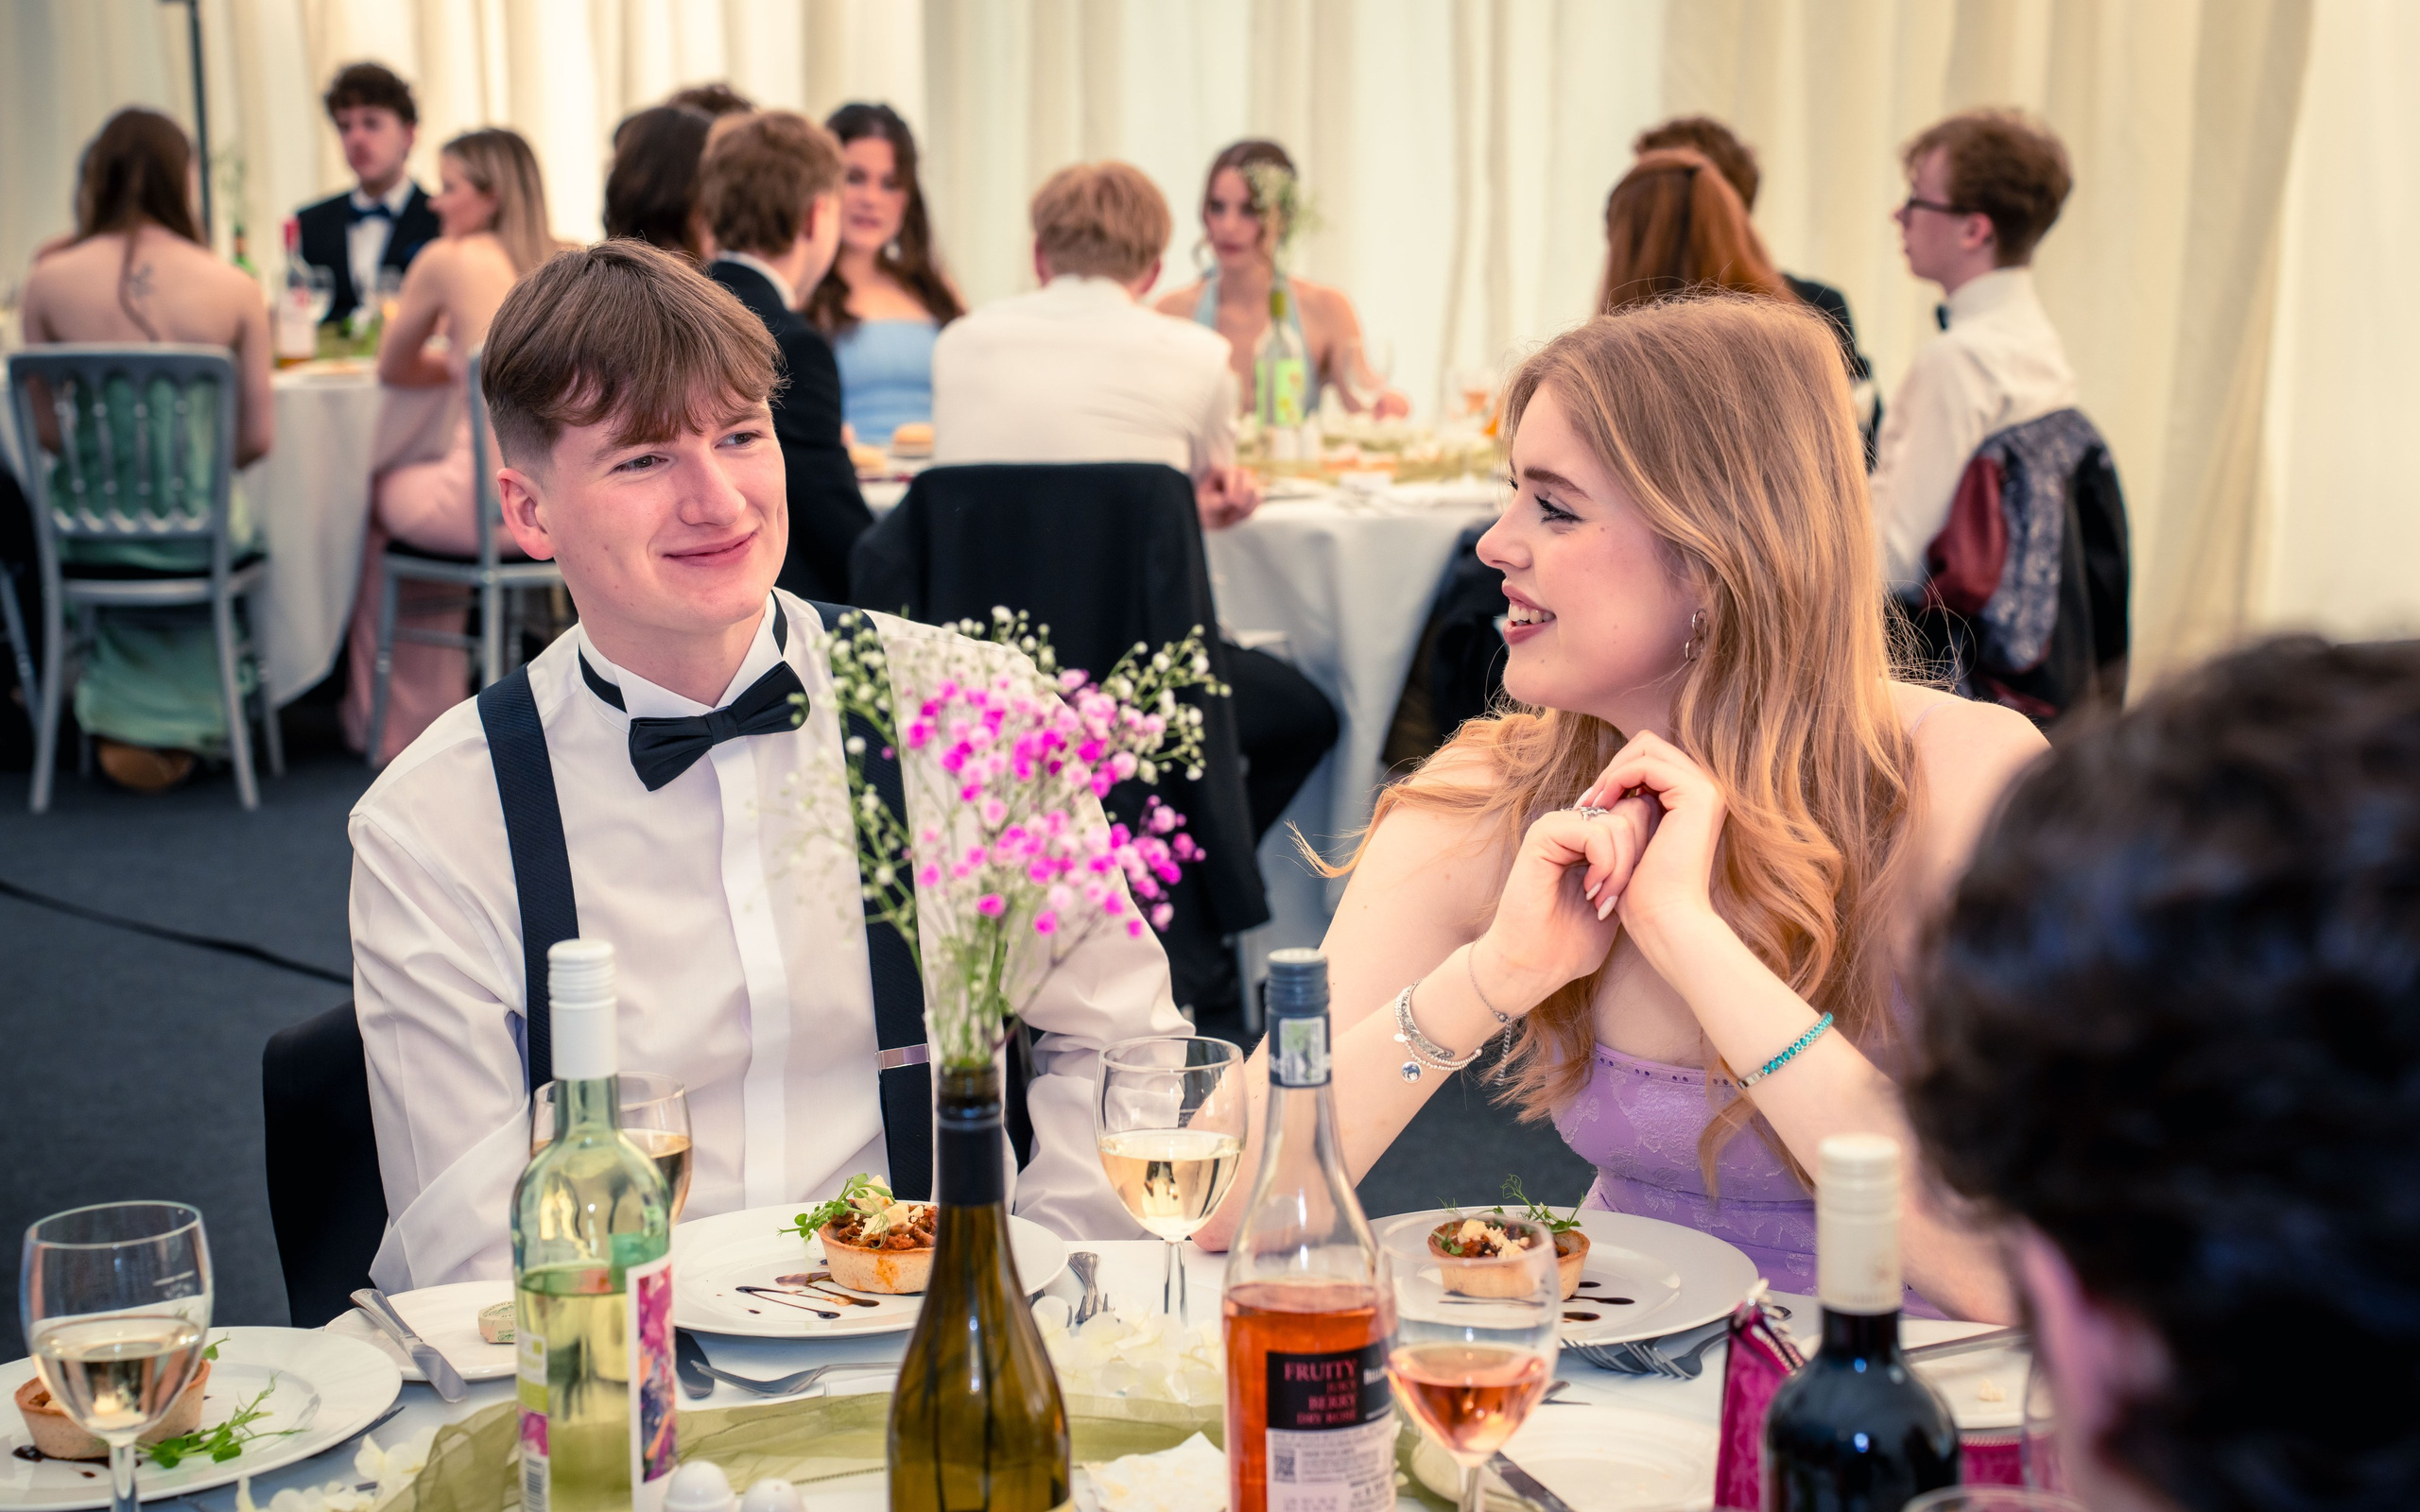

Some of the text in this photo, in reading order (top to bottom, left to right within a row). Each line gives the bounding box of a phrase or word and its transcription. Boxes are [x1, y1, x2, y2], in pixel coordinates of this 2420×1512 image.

[1284, 1359, 1357, 1382] FRUITY
[1308, 1394, 1357, 1411] BERRY
[1296, 1412, 1322, 1425] DRY
